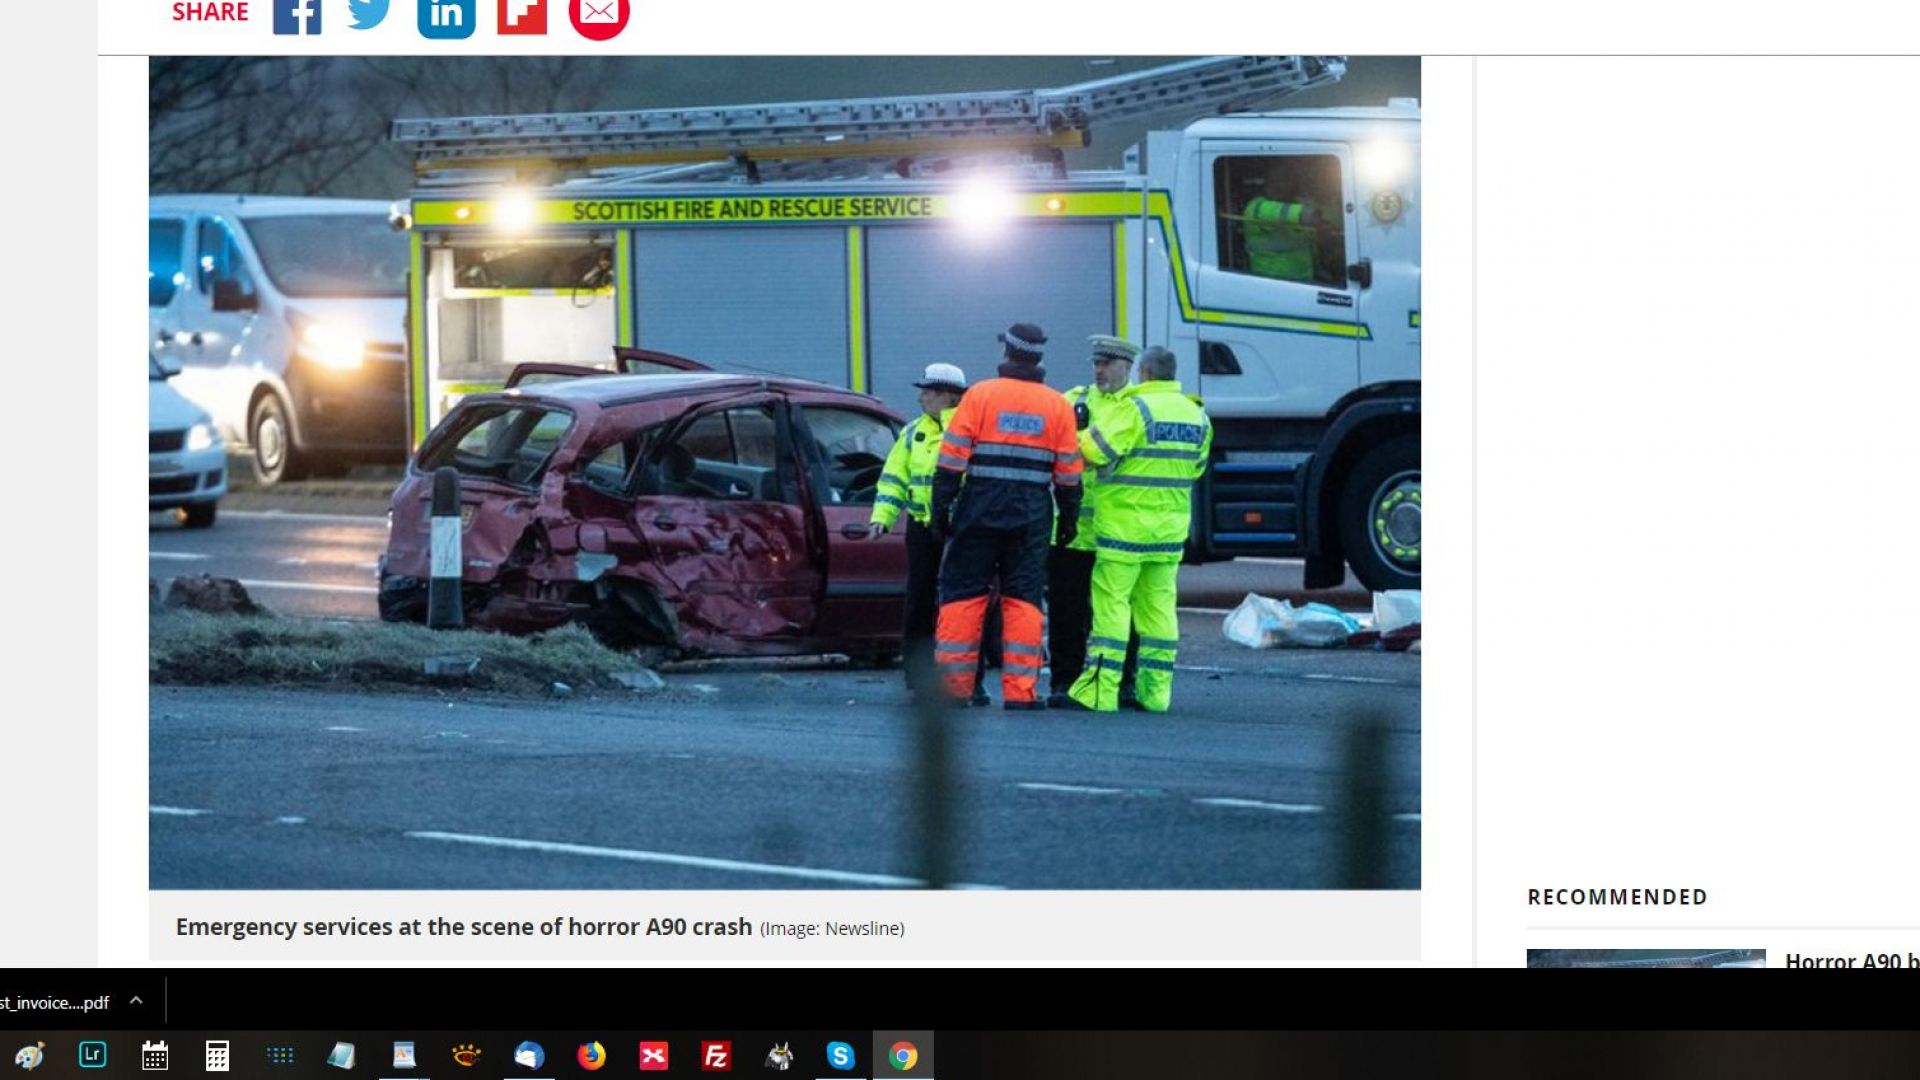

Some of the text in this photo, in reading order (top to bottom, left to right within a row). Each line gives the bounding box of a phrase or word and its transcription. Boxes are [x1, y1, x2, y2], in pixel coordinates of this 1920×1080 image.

[172, 1, 249, 21] SHARE
[573, 197, 932, 220] SCOTTISH FIRE AND RESCUE SERVICE
[1528, 888, 1707, 906] RECOMMENDED
[176, 916, 905, 940] Emergency services at the scene of horror A90 crash (Image: Newsline)
[1786, 953, 1857, 968] Horror
[1863, 953, 1902, 968] A90
[85, 1046, 100, 1061] Lr
[705, 1045, 728, 1068] Fz
